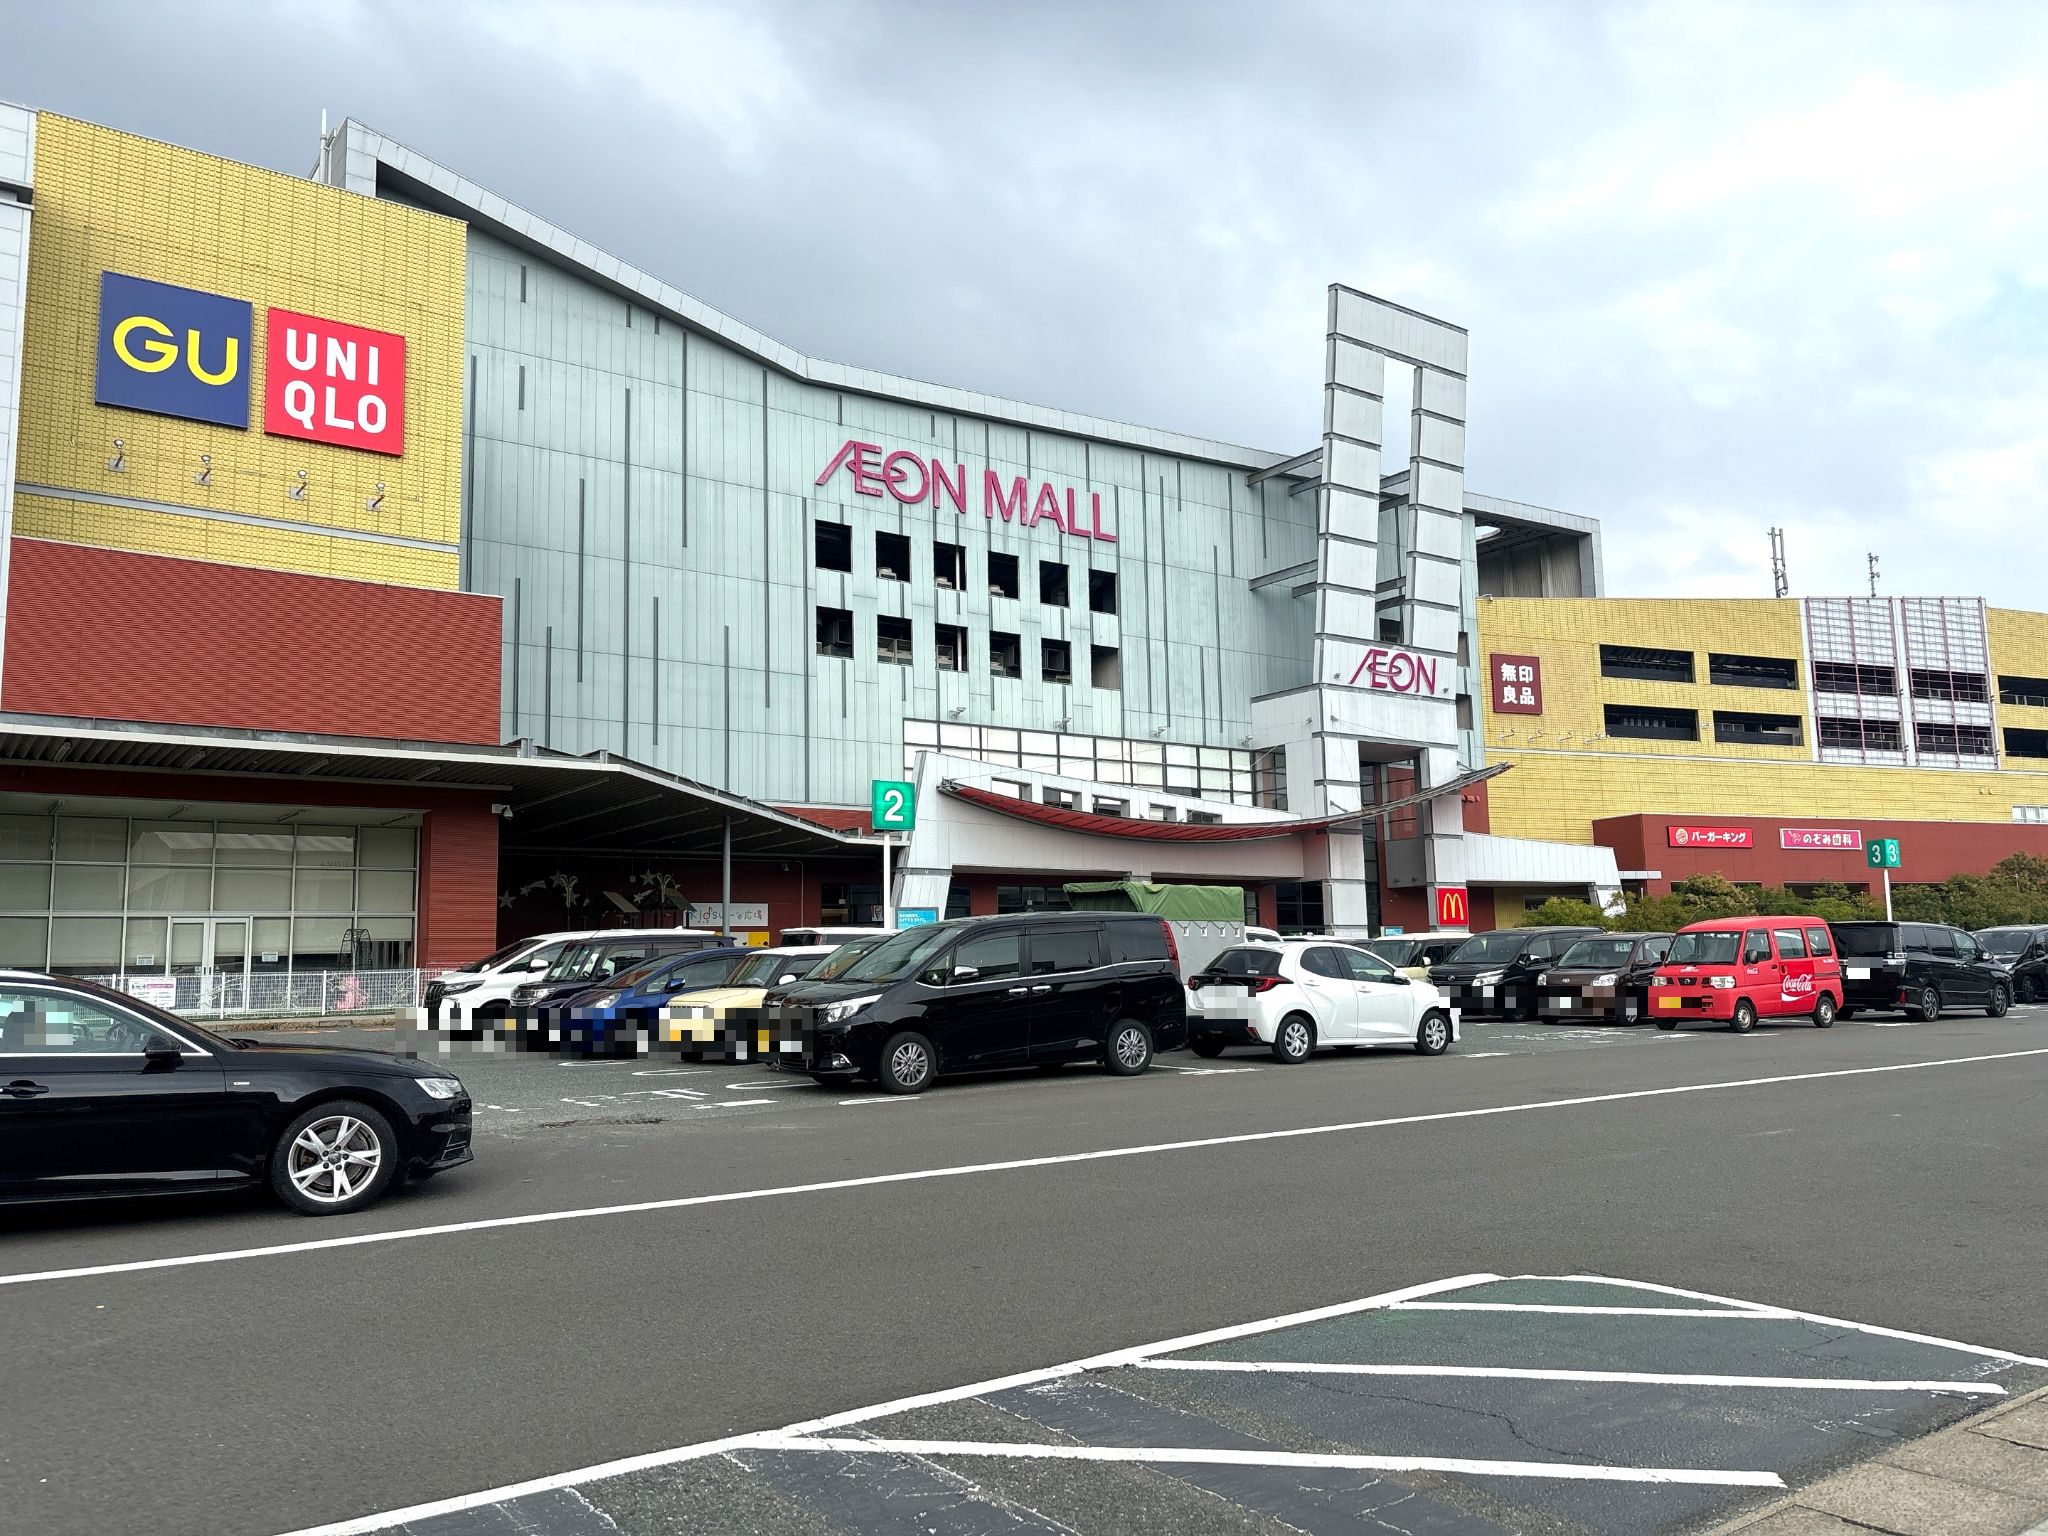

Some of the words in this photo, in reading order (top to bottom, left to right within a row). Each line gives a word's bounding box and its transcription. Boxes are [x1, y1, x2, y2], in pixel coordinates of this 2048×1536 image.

[113, 316, 239, 386] GU
[286, 327, 379, 386] UNI
[283, 379, 388, 434] QLO
[984, 469, 1118, 543] MALL
[1500, 662, 1534, 684] 無印
[1502, 684, 1536, 706] 良品
[884, 789, 904, 822] 2
[1692, 831, 1747, 844] バーガーキング
[1803, 833, 1853, 846] のぞみ歯科
[1872, 844, 1881, 864] 3
[1888, 843, 1897, 863] 3
